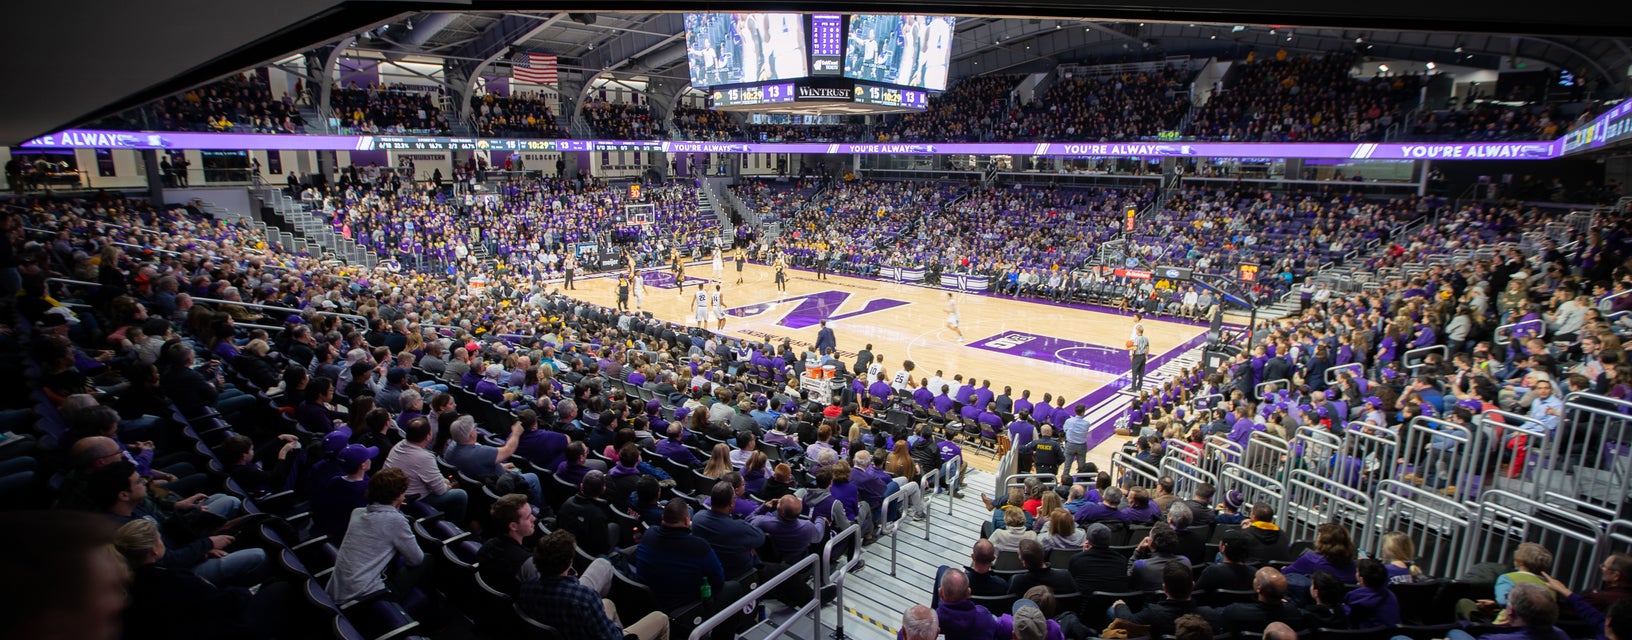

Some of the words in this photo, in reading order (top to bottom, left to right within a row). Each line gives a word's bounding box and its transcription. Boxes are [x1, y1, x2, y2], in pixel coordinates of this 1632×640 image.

[728, 89, 738, 100] 15
[742, 90, 762, 100] 10:29
[768, 86, 779, 97] 13
[800, 86, 850, 97] WINTRUST
[869, 87, 880, 99] 15
[884, 93, 901, 102] 10:29
[906, 92, 914, 102] 13
[528, 140, 549, 149] 10:29
[560, 141, 569, 149] 13
[1064, 145, 1107, 154] YOU'RE
[1401, 145, 1461, 158] YOU'RE
[631, 190, 640, 198] 30
[895, 268, 901, 281] N
[1242, 272, 1254, 280] 30
[958, 276, 966, 290] N
[870, 367, 877, 375] 10
[895, 375, 904, 383] 25
